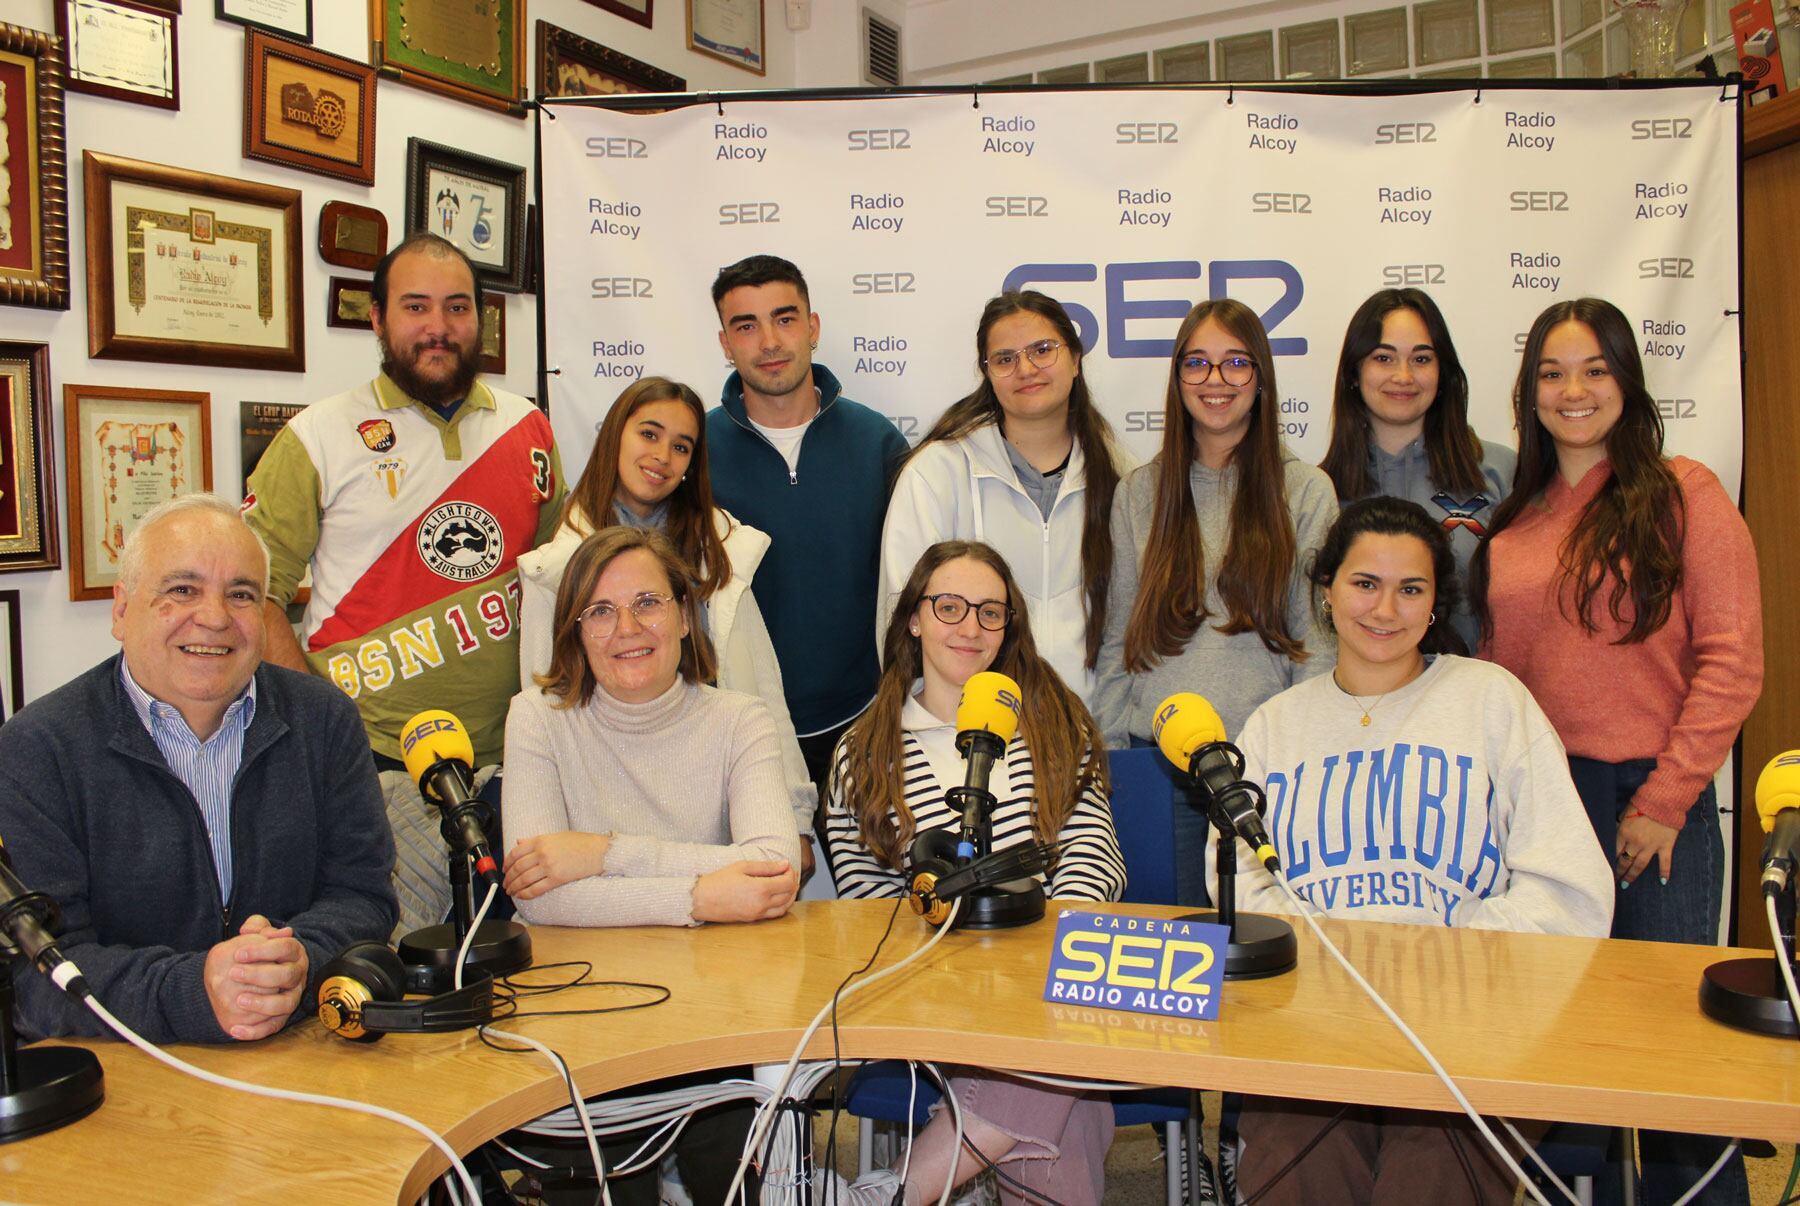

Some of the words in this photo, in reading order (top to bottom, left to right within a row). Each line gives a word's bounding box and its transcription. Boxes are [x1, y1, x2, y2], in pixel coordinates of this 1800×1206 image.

[982, 116, 1035, 132] Radio
[1248, 114, 1298, 129] Radio
[1506, 112, 1555, 127] Radio
[1632, 118, 1692, 139] SER
[715, 124, 767, 139] Radio
[848, 129, 910, 150] SER
[1116, 123, 1178, 144] SER
[1375, 123, 1436, 144] SER
[586, 137, 648, 158] SER
[983, 138, 1034, 156] Alcoy
[1249, 134, 1296, 154] Alcoy
[1507, 133, 1554, 151] Alcoy
[717, 145, 766, 162] Alcoy
[1119, 189, 1171, 204] Radio
[1379, 187, 1431, 202] Radio
[1636, 183, 1687, 198] Radio
[590, 199, 641, 217] Radio
[851, 194, 904, 209] Radio
[986, 197, 1048, 216] SER
[1253, 193, 1312, 213] SER
[1510, 192, 1569, 211] SER
[719, 203, 780, 225] SER
[1120, 210, 1171, 227] Alcoy
[1381, 208, 1431, 225] Alcoy
[1636, 204, 1688, 219] Alcoy
[590, 219, 640, 240] Alcoy
[852, 215, 903, 232] Alcoy
[1511, 253, 1560, 267] Radio
[1639, 258, 1694, 278] SER
[853, 273, 915, 294] SER
[1383, 264, 1445, 288] SER
[1512, 274, 1560, 292] Alcoy
[592, 278, 653, 298] SER
[1643, 320, 1685, 335] Radio
[593, 341, 644, 356] Radio
[854, 336, 907, 352] Radio
[1644, 341, 1685, 360] Alcoy
[595, 363, 644, 380] Alcoy
[855, 358, 906, 376] Alcoy
[1281, 398, 1309, 414] dio
[1657, 399, 1697, 419] ER
[1125, 411, 1167, 432] SE
[1278, 422, 1309, 438] coy
[378, 462, 399, 470] 1979
[530, 447, 550, 498] 3
[426, 505, 493, 530] LIGHTGOW
[434, 561, 493, 579] AUSTRALIA
[995, 689, 1021, 719] SE
[1154, 703, 1179, 740] ER
[404, 719, 458, 756] SER
[1266, 743, 1502, 901] OLUMBIA
[1094, 916, 1190, 935] CADENA
[1055, 930, 1215, 996] SER
[1052, 982, 1122, 1005] RADIO
[1132, 991, 1209, 1014] ALCOY
